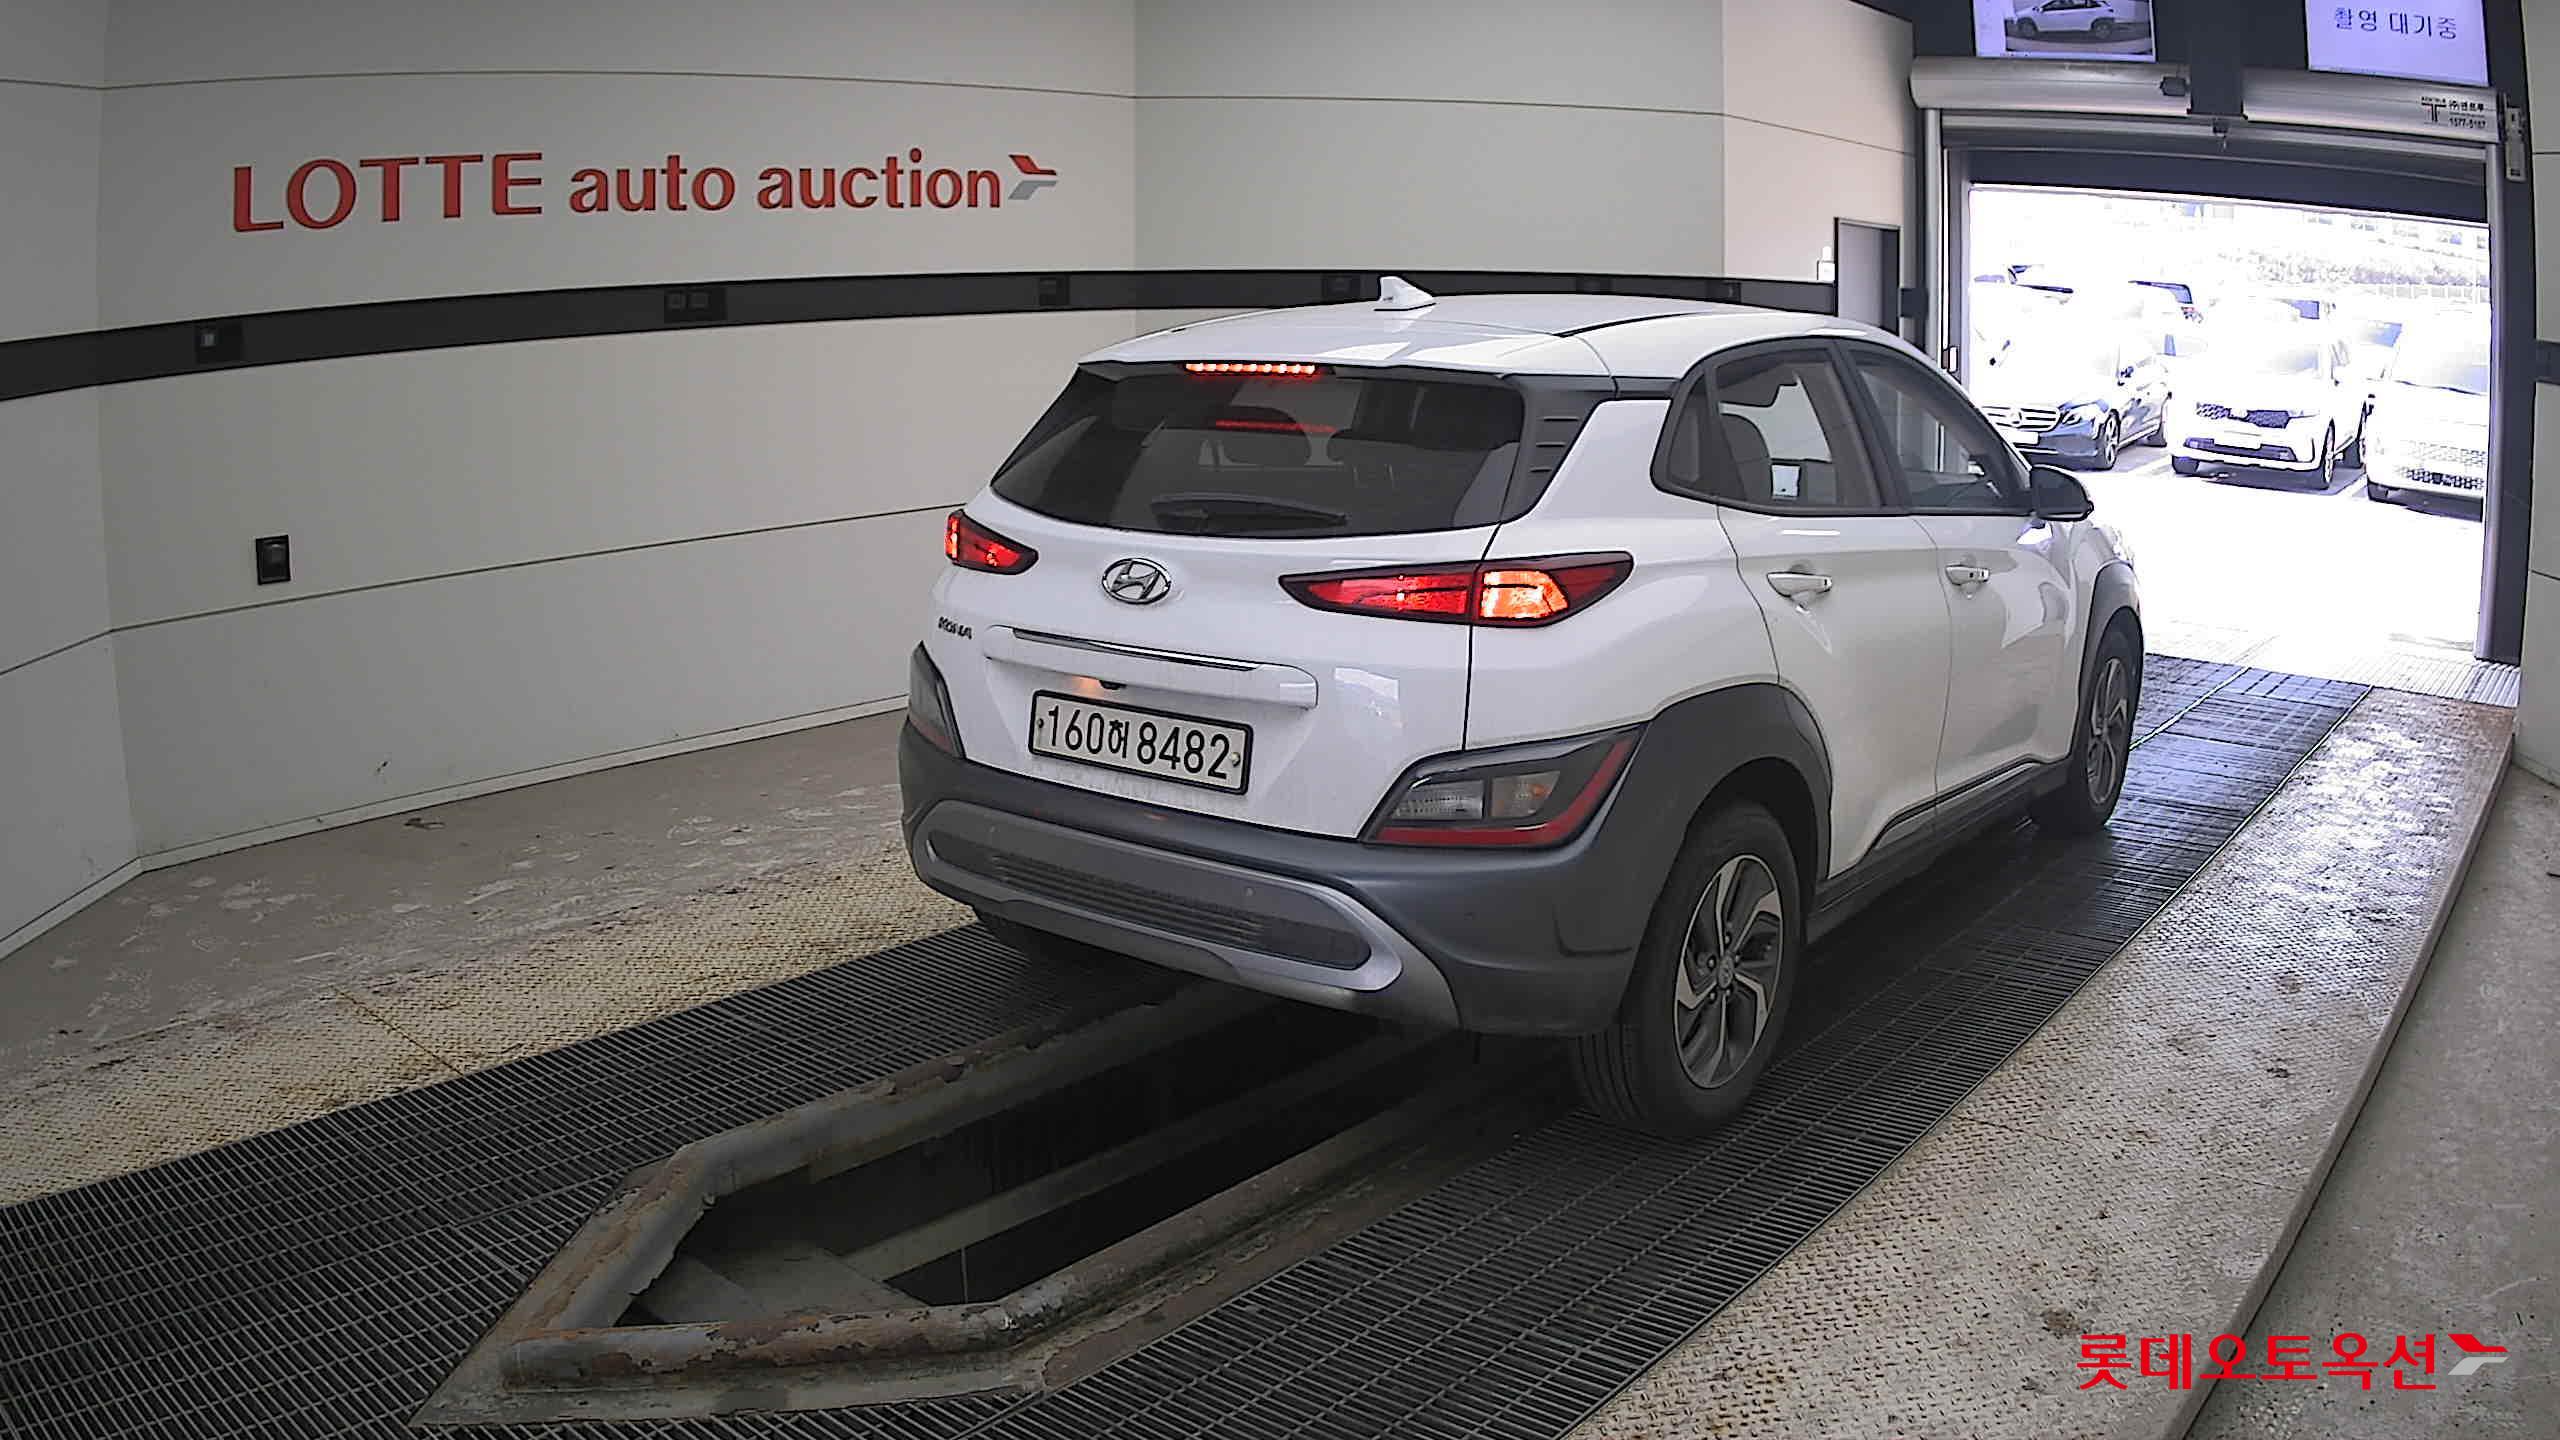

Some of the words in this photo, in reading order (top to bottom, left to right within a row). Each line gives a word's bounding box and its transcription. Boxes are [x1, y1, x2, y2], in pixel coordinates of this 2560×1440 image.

[2336, 7, 2377, 32] 촬영
[2389, 12, 2457, 40] 대기중
[236, 152, 543, 232] LOTTE
[570, 154, 736, 212] auto
[758, 148, 1002, 209] auction
[1048, 704, 1230, 780] 160허8482
